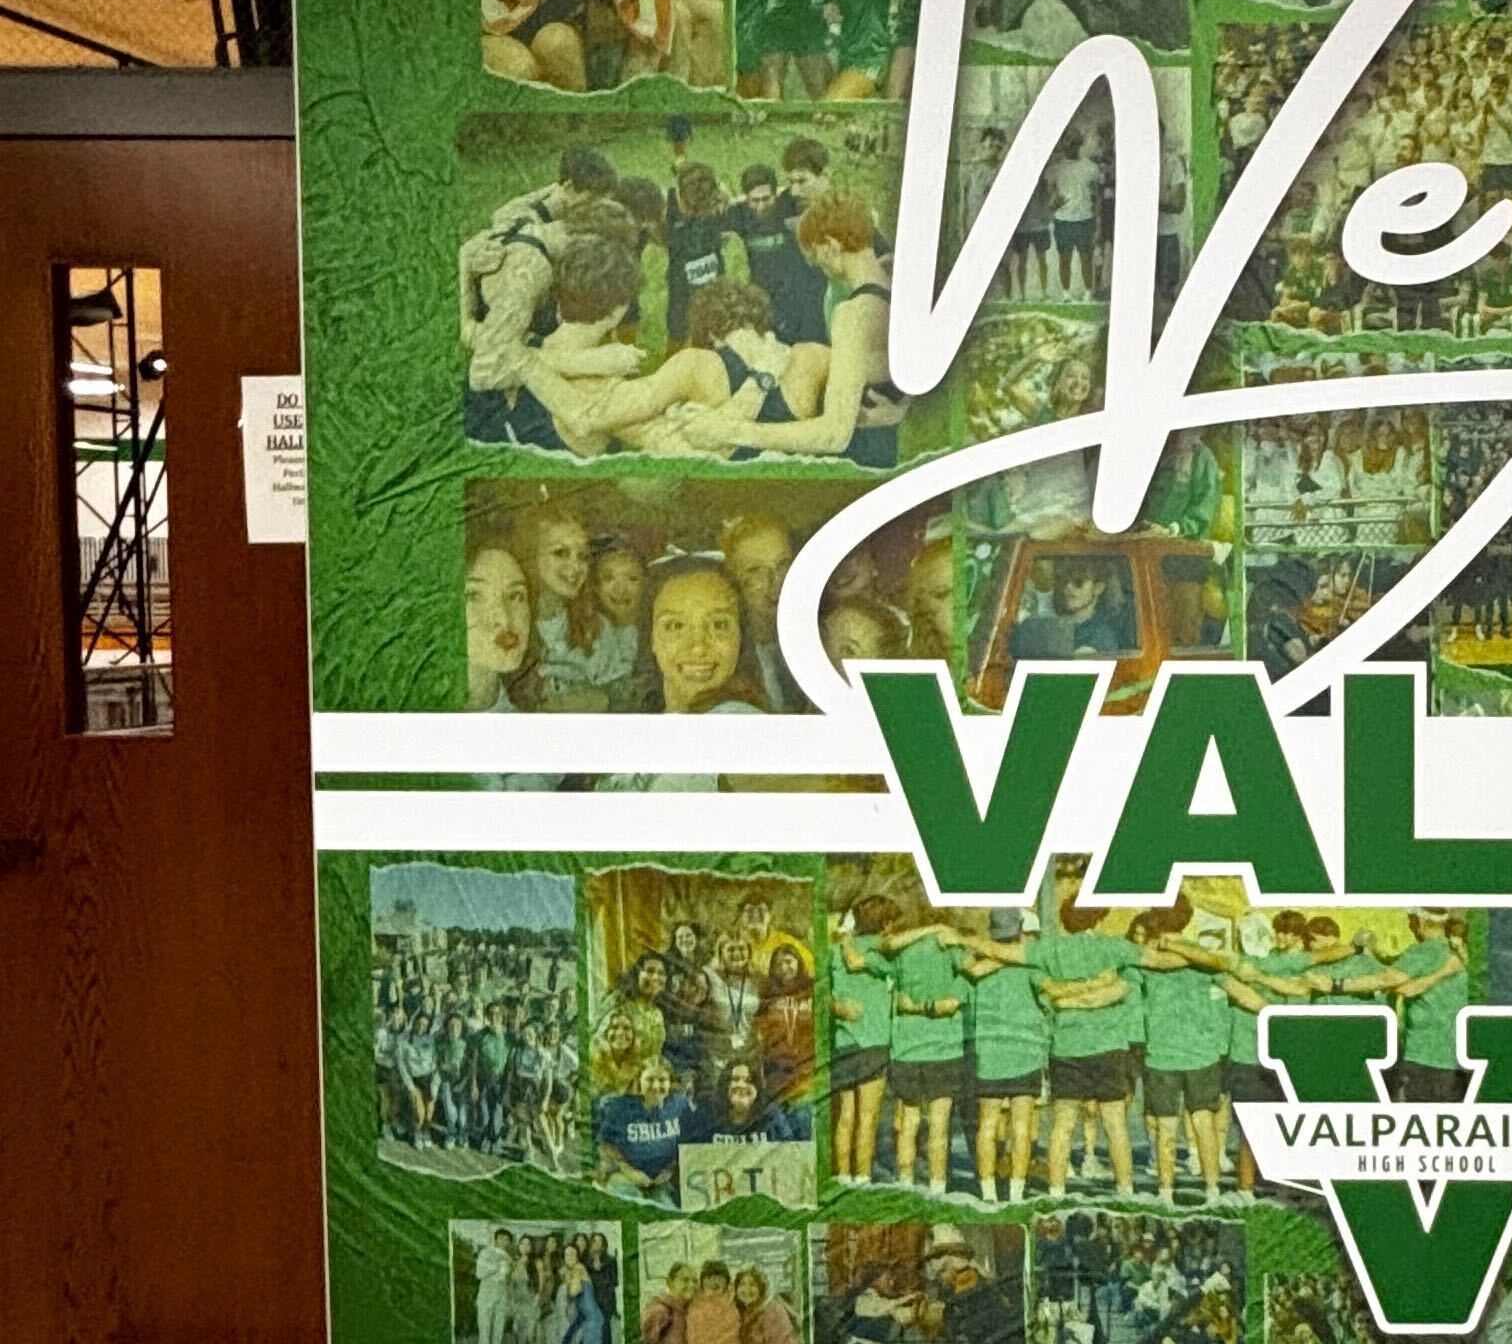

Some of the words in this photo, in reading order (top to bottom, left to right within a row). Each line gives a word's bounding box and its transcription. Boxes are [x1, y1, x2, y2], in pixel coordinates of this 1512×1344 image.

[277, 393, 299, 408] DO
[273, 414, 304, 429] USE
[1357, 1155, 1405, 1173] HIGH
[1418, 1155, 1497, 1173] SCHOOL
